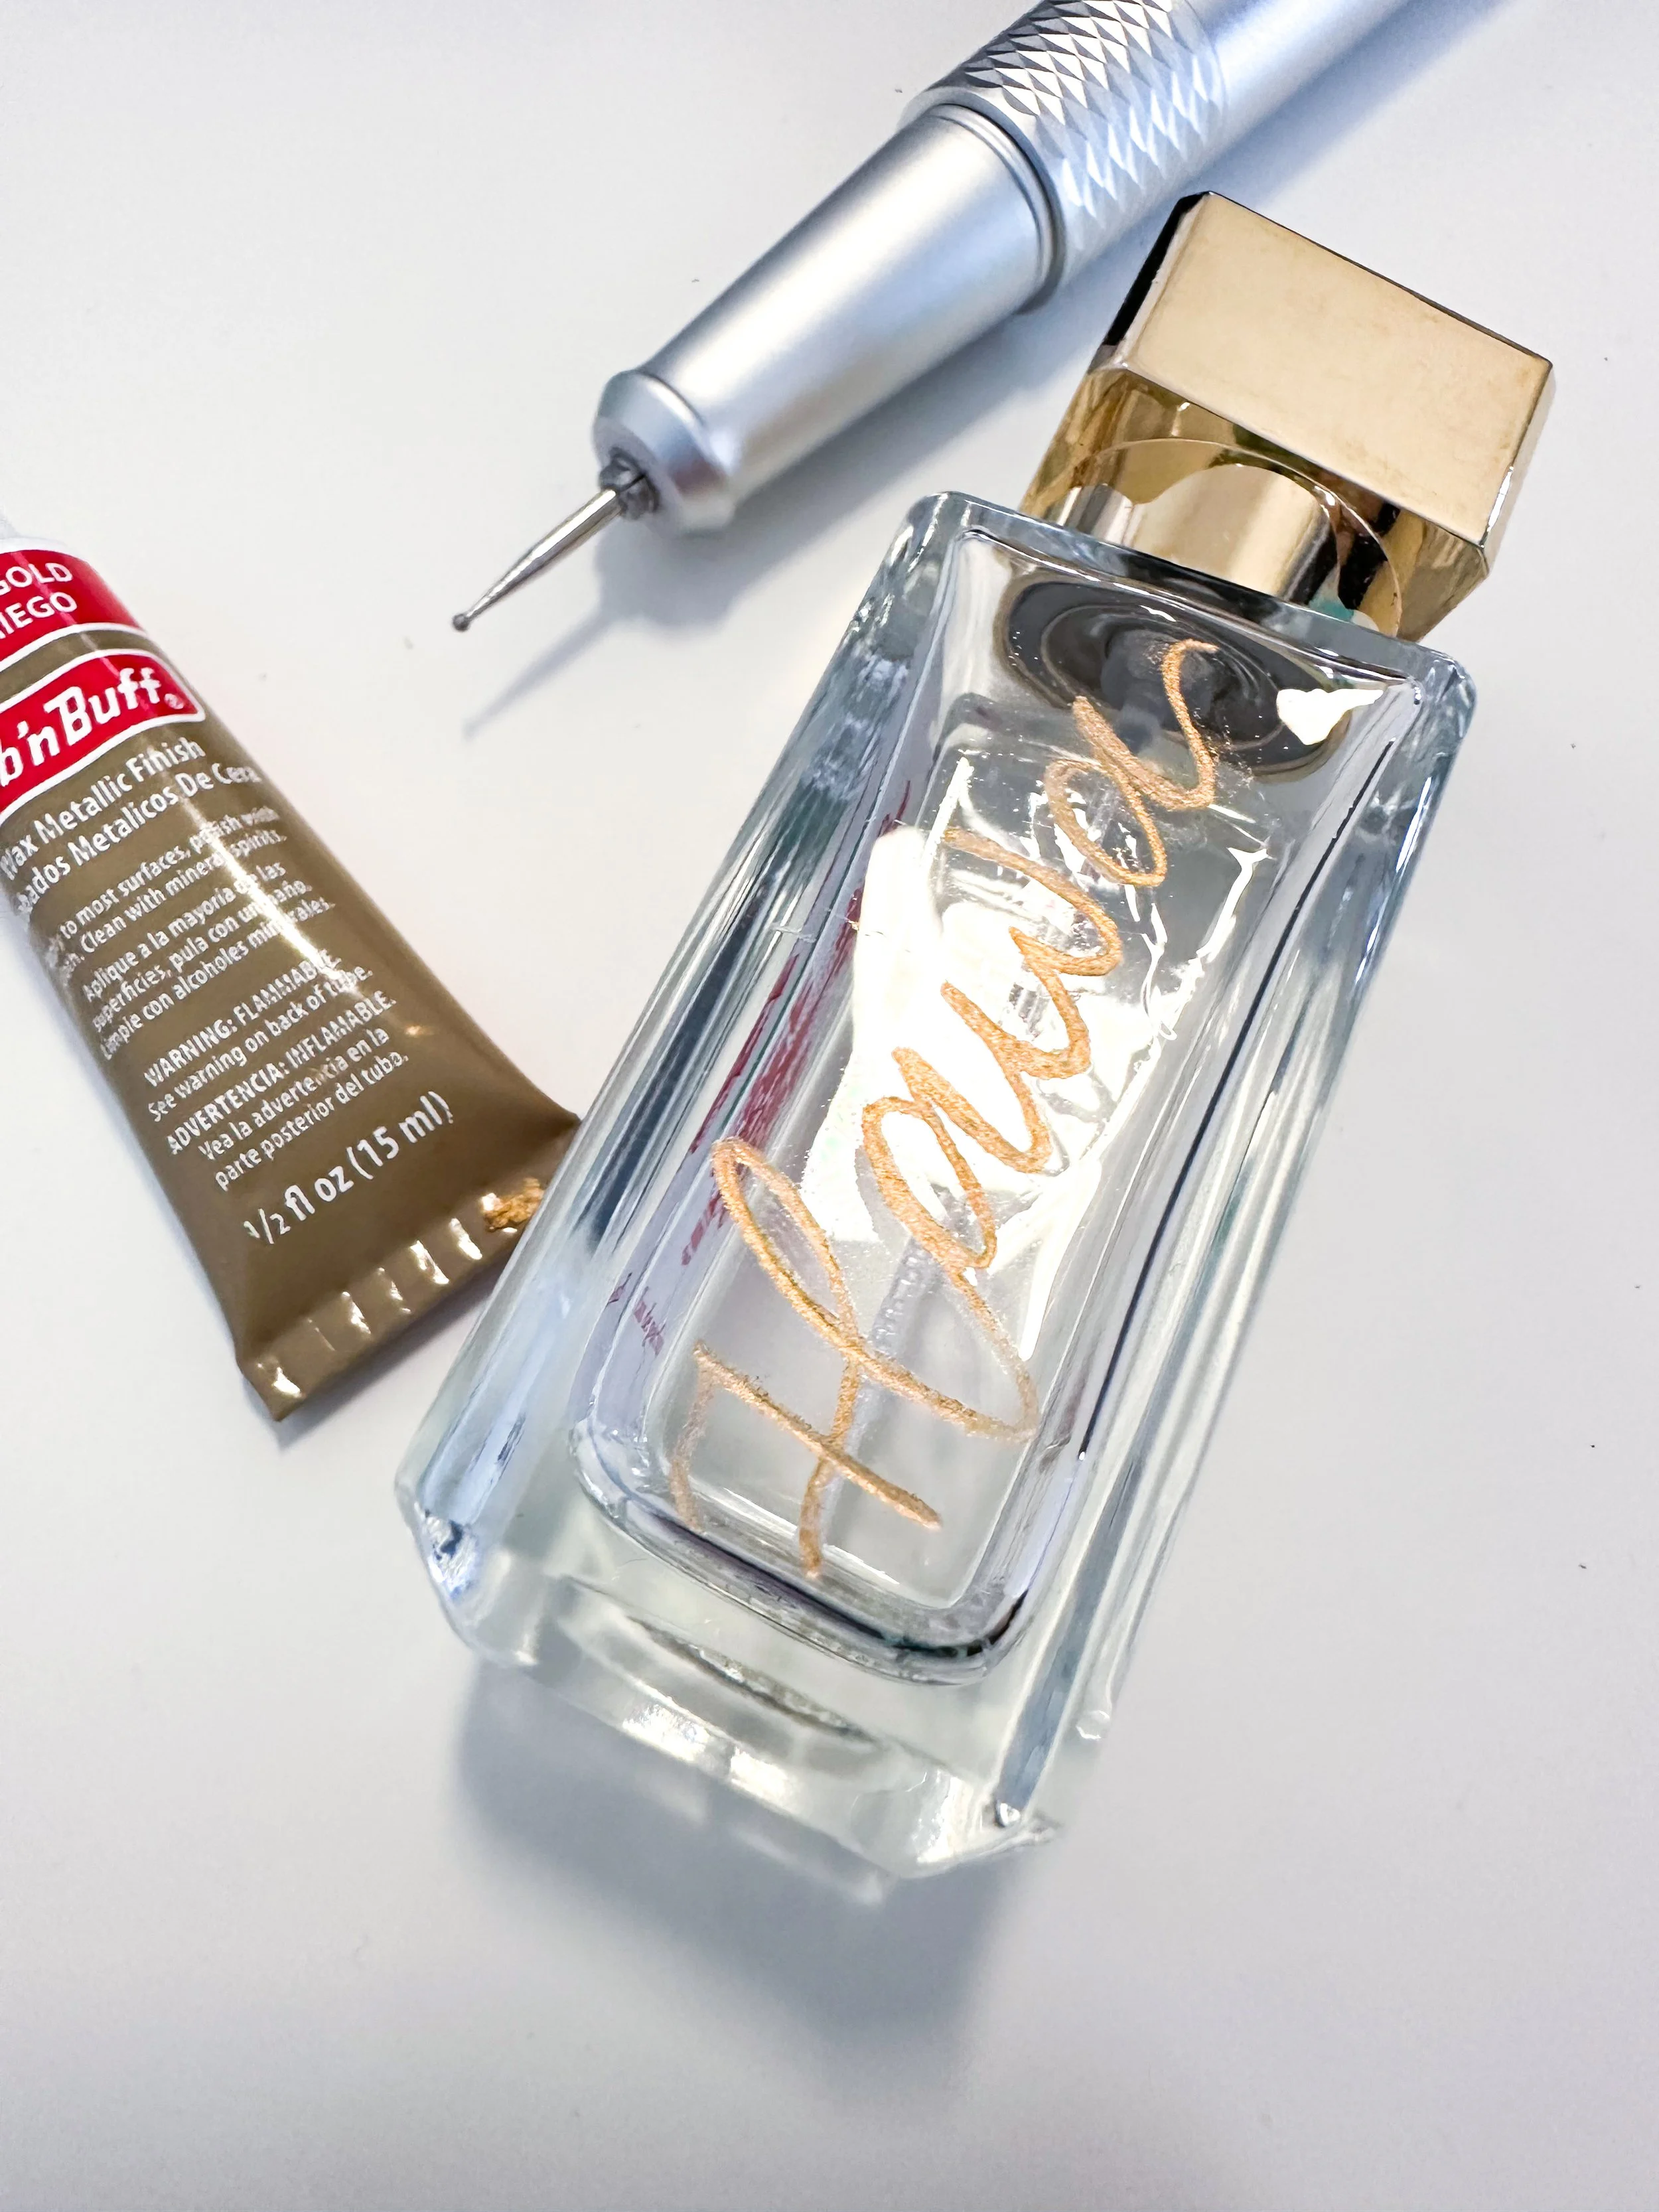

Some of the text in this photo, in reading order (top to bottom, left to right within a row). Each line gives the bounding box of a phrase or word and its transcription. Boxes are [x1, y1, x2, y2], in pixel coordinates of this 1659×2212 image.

[0, 591, 78, 640] IEGO
[34, 773, 132, 844] Metallic
[125, 737, 205, 782] Finish
[68, 783, 179, 865] Metalicos
[174, 773, 212, 798] De
[60, 921, 77, 938] to
[76, 889, 119, 926] most
[117, 846, 191, 897] surfaces,
[81, 917, 126, 952] Clean
[124, 888, 167, 921] with
[84, 952, 141, 1002] Aplique
[137, 944, 152, 958] a
[147, 931, 169, 950] la
[168, 887, 236, 937] mayoria
[143, 994, 174, 1019] con
[172, 941, 249, 999] alcoholes
[170, 937, 208, 971] pula
[208, 916, 240, 942] con
[144, 1019, 237, 1086] WARNING:
[149, 1094, 177, 1122] See
[175, 1047, 247, 1098] warning
[245, 1031, 269, 1053] on
[265, 1002, 309, 1036] back
[307, 984, 326, 1009] of
[167, 991, 396, 1154] ADVERTENCIA: INFLAMABLE.
[198, 1029, 389, 1159] Vea la advertencia en la
[216, 1052, 408, 1191] parte posterior del tubo.
[315, 1166, 354, 1201] oz
[347, 1126, 399, 1179] (15
[399, 1092, 453, 1143] ml)
